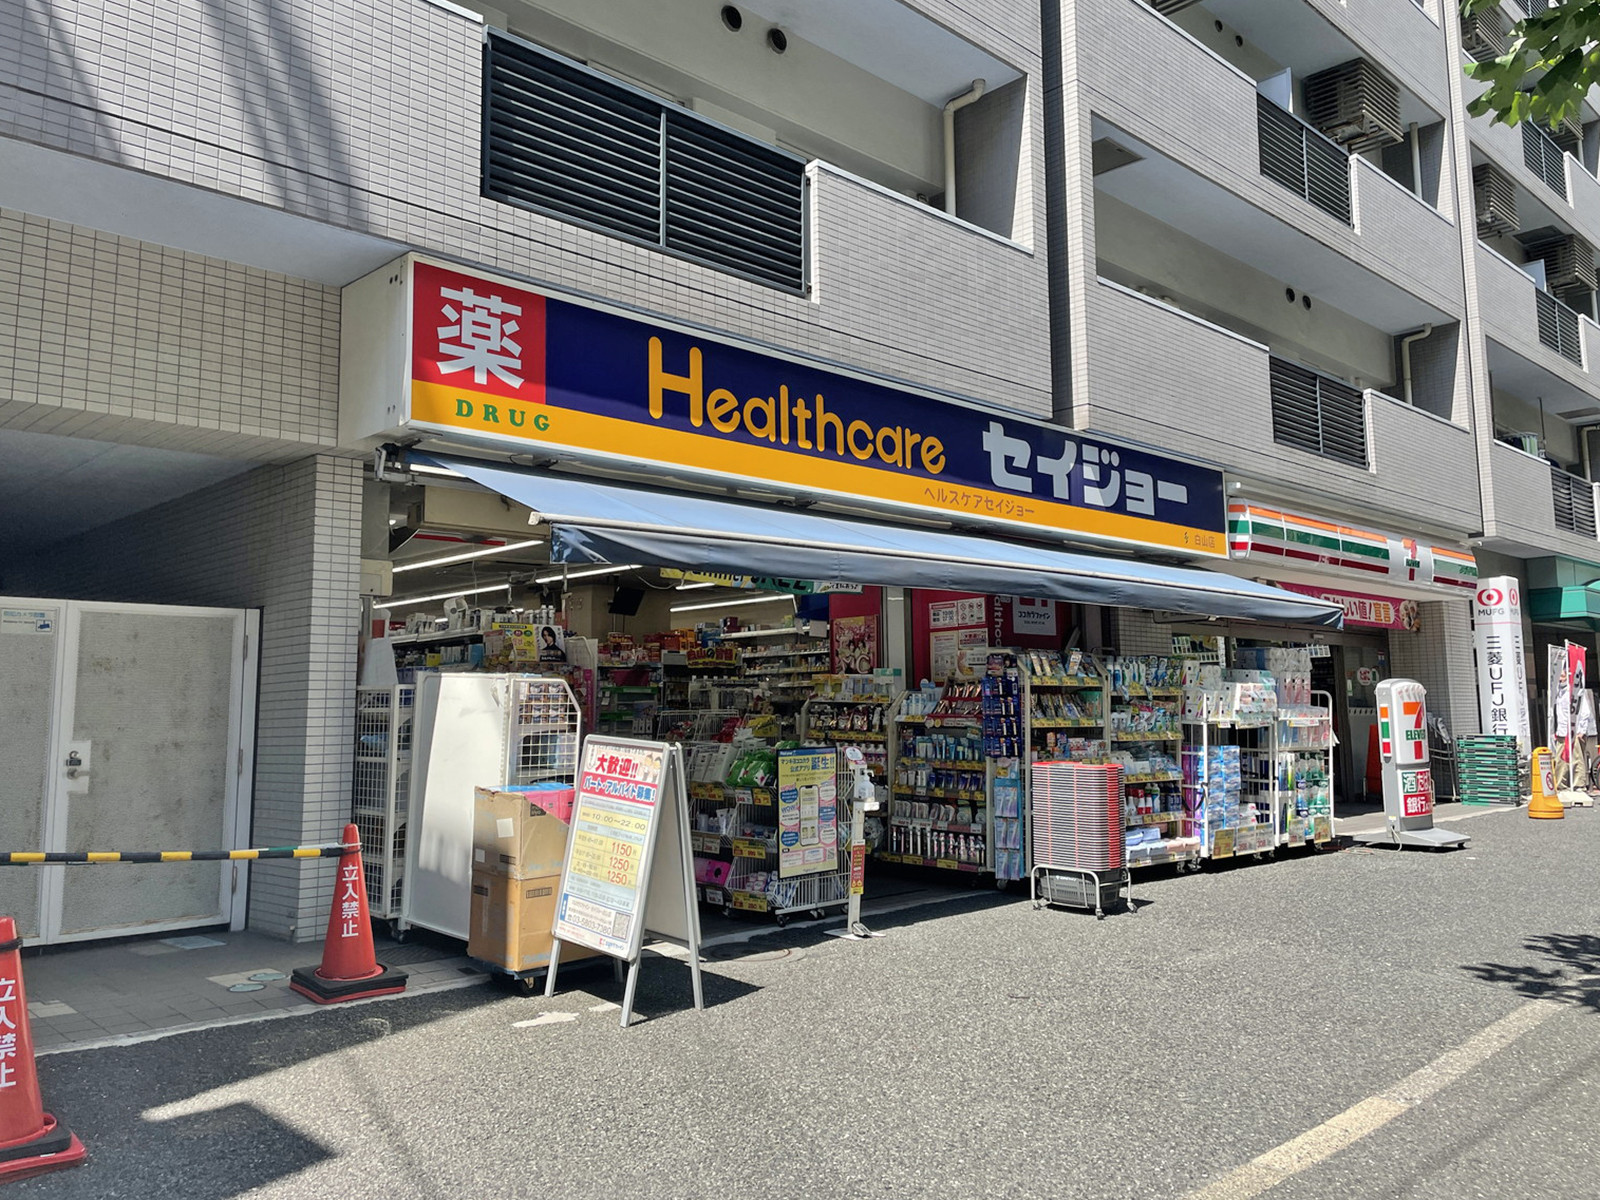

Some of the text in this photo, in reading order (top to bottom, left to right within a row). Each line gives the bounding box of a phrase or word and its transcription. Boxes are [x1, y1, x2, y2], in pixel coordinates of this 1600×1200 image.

[436, 286, 525, 390] 薬
[455, 398, 550, 432] DRUG
[648, 336, 946, 475] Healthcare
[982, 420, 1188, 516] セイジョー
[924, 487, 1035, 517] ヘルスケアセイジョー
[1478, 608, 1505, 616] MUFG
[1403, 773, 1416, 793] 酒
[609, 856, 630, 872] 1250
[612, 842, 632, 857] 1150
[607, 870, 628, 886] 1250
[341, 862, 360, 939] 立入禁止
